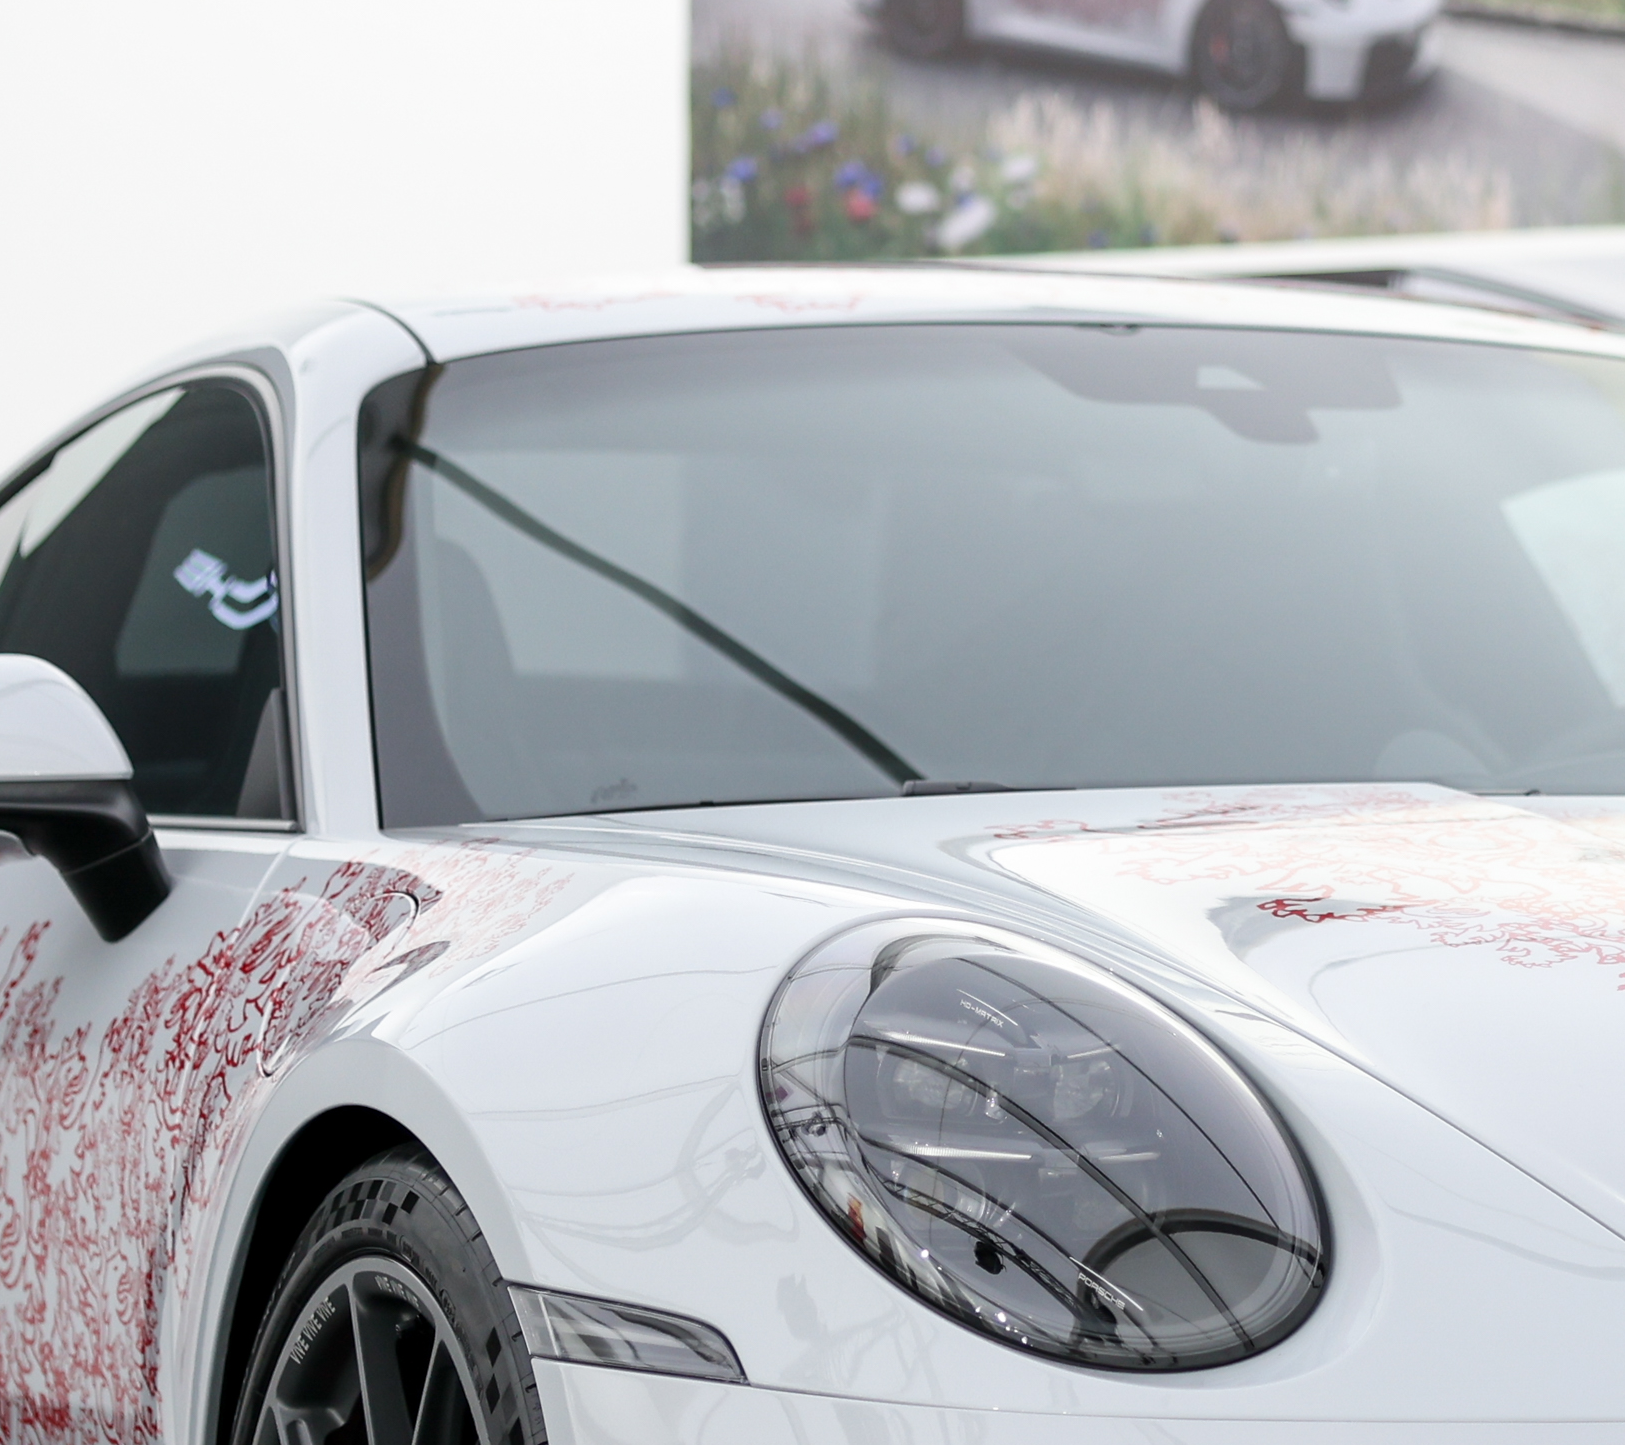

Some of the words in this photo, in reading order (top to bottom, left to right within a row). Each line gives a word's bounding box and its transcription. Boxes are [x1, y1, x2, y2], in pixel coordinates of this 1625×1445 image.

[959, 999, 1004, 1028] HD-MATRIX
[1078, 1272, 1125, 1310] PORSCHE
[289, 1334, 310, 1365] VIVE
[303, 1314, 323, 1342] VIVE
[316, 1296, 336, 1322] VIVE
